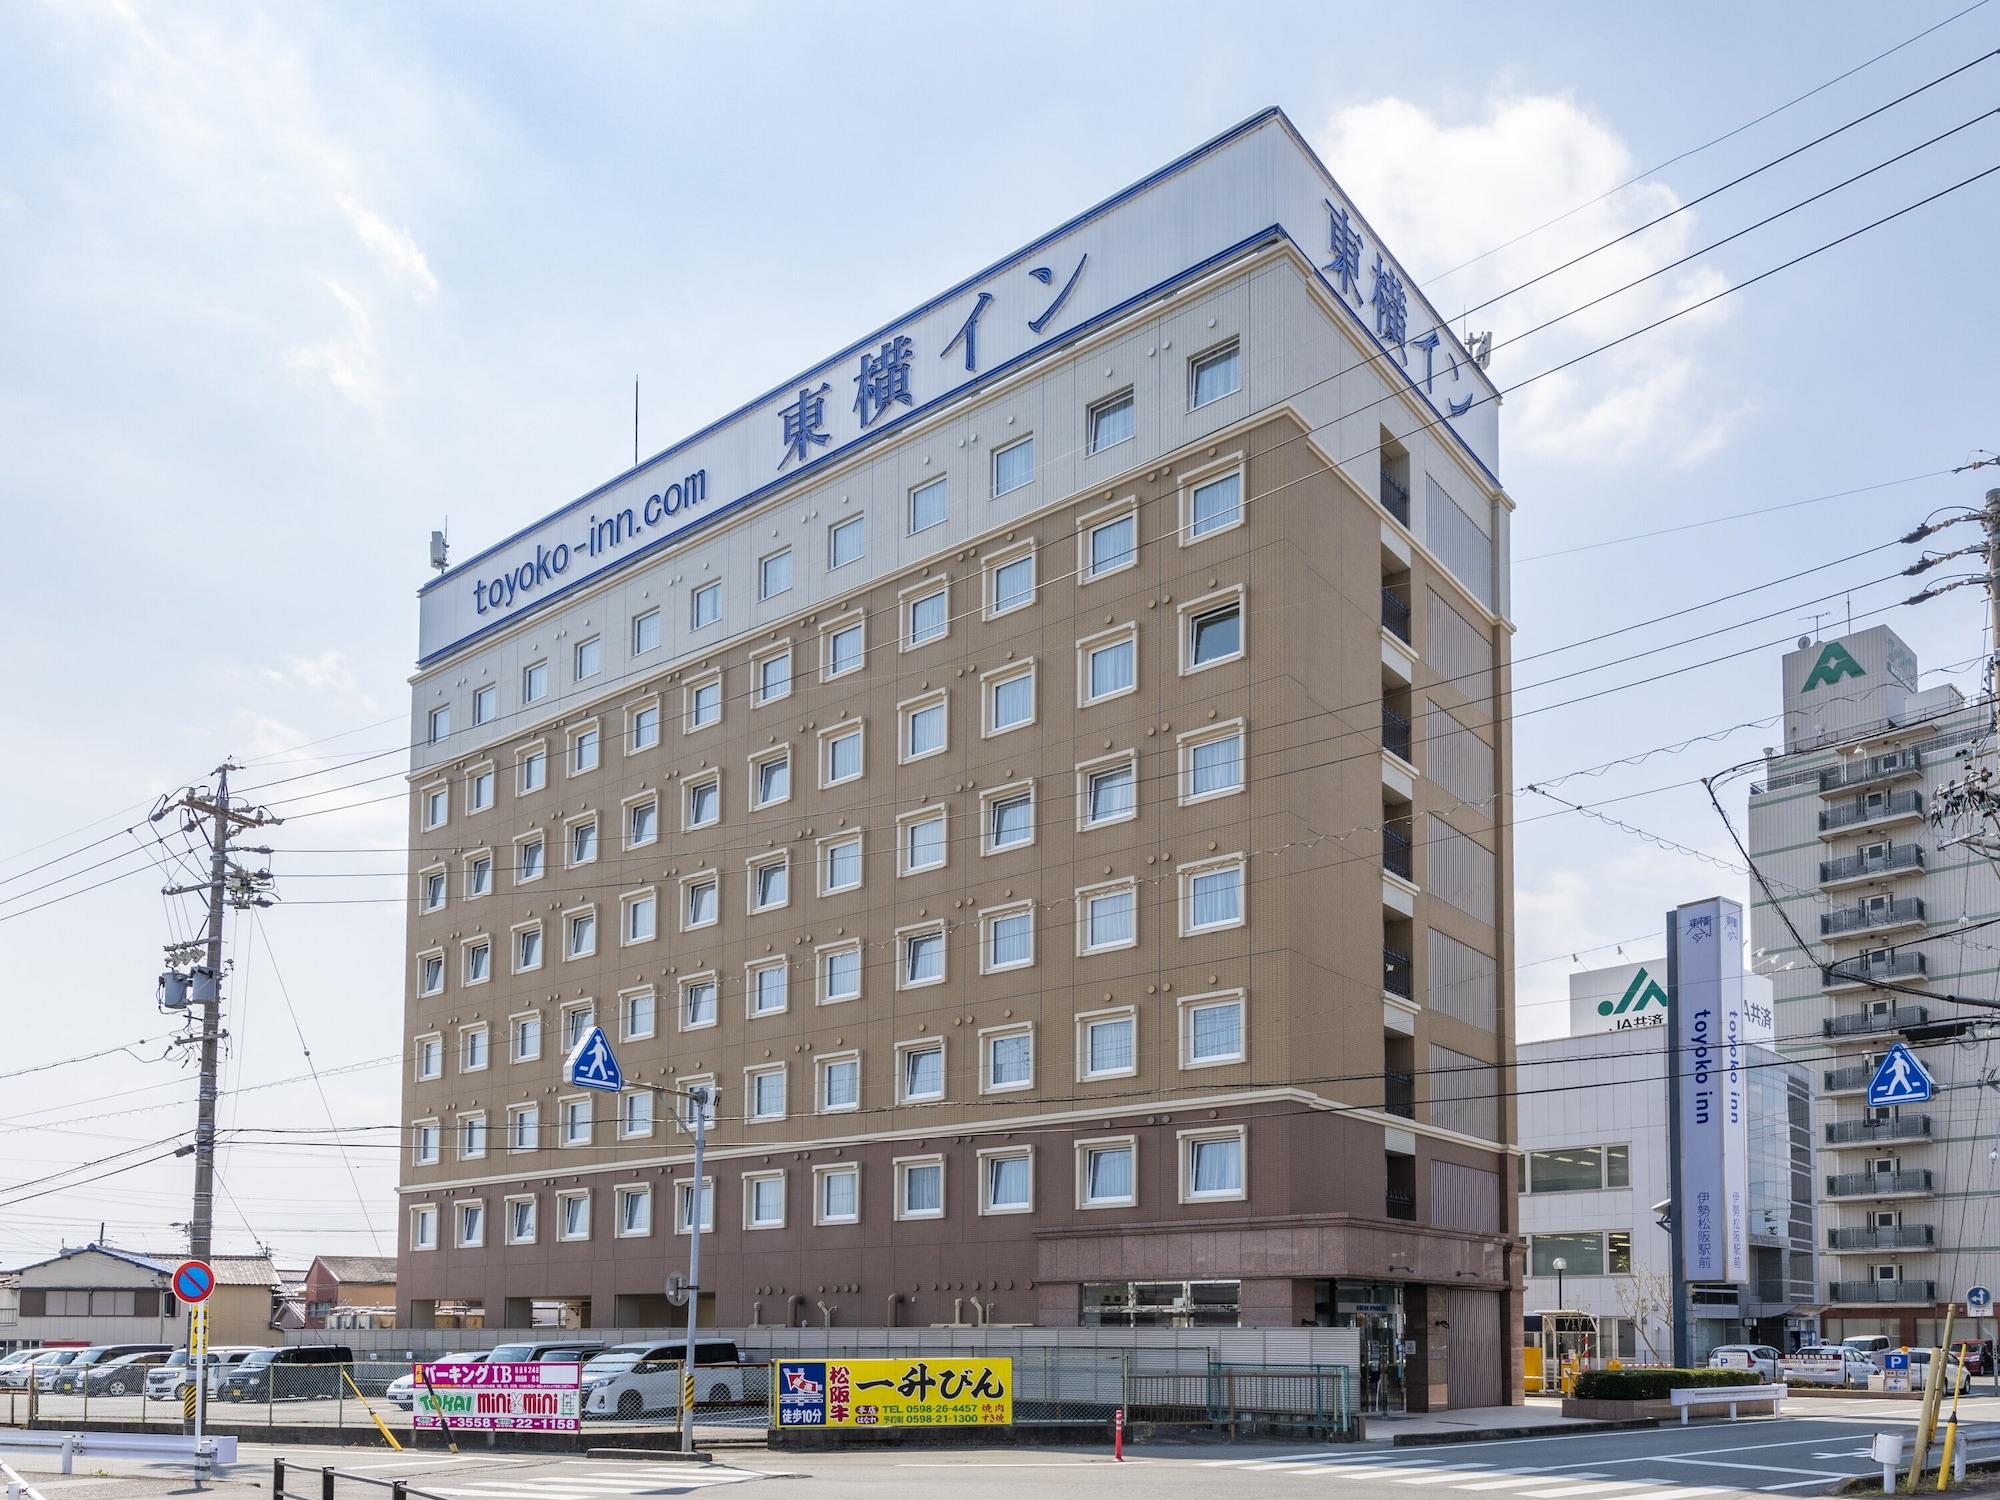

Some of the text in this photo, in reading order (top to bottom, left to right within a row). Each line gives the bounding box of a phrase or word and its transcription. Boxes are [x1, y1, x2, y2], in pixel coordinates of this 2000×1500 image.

[1321, 197, 1474, 418] 東横イン
[776, 252, 1088, 470] 東横イン
[473, 465, 708, 615] toyoko-inn.com
[1691, 1009, 1713, 1125] toyoko inn
[1727, 1010, 1740, 1124] toyoko inn
[1697, 1191, 1711, 1269] 伊勢松阪駅前
[419, 1394, 472, 1412] TOKAI
[477, 1393, 511, 1414] mini
[523, 1393, 558, 1415] mini
[829, 1366, 850, 1423] 松阪牛
[855, 1362, 1005, 1403] 一升びん
[515, 1418, 576, 1430] 22-1158
[782, 1408, 822, 1424] 徒歩10分
[882, 1405, 903, 1413] TEL
[906, 1405, 978, 1413] 0598-26-4457
[906, 1415, 978, 1424] 0598-21-1300
